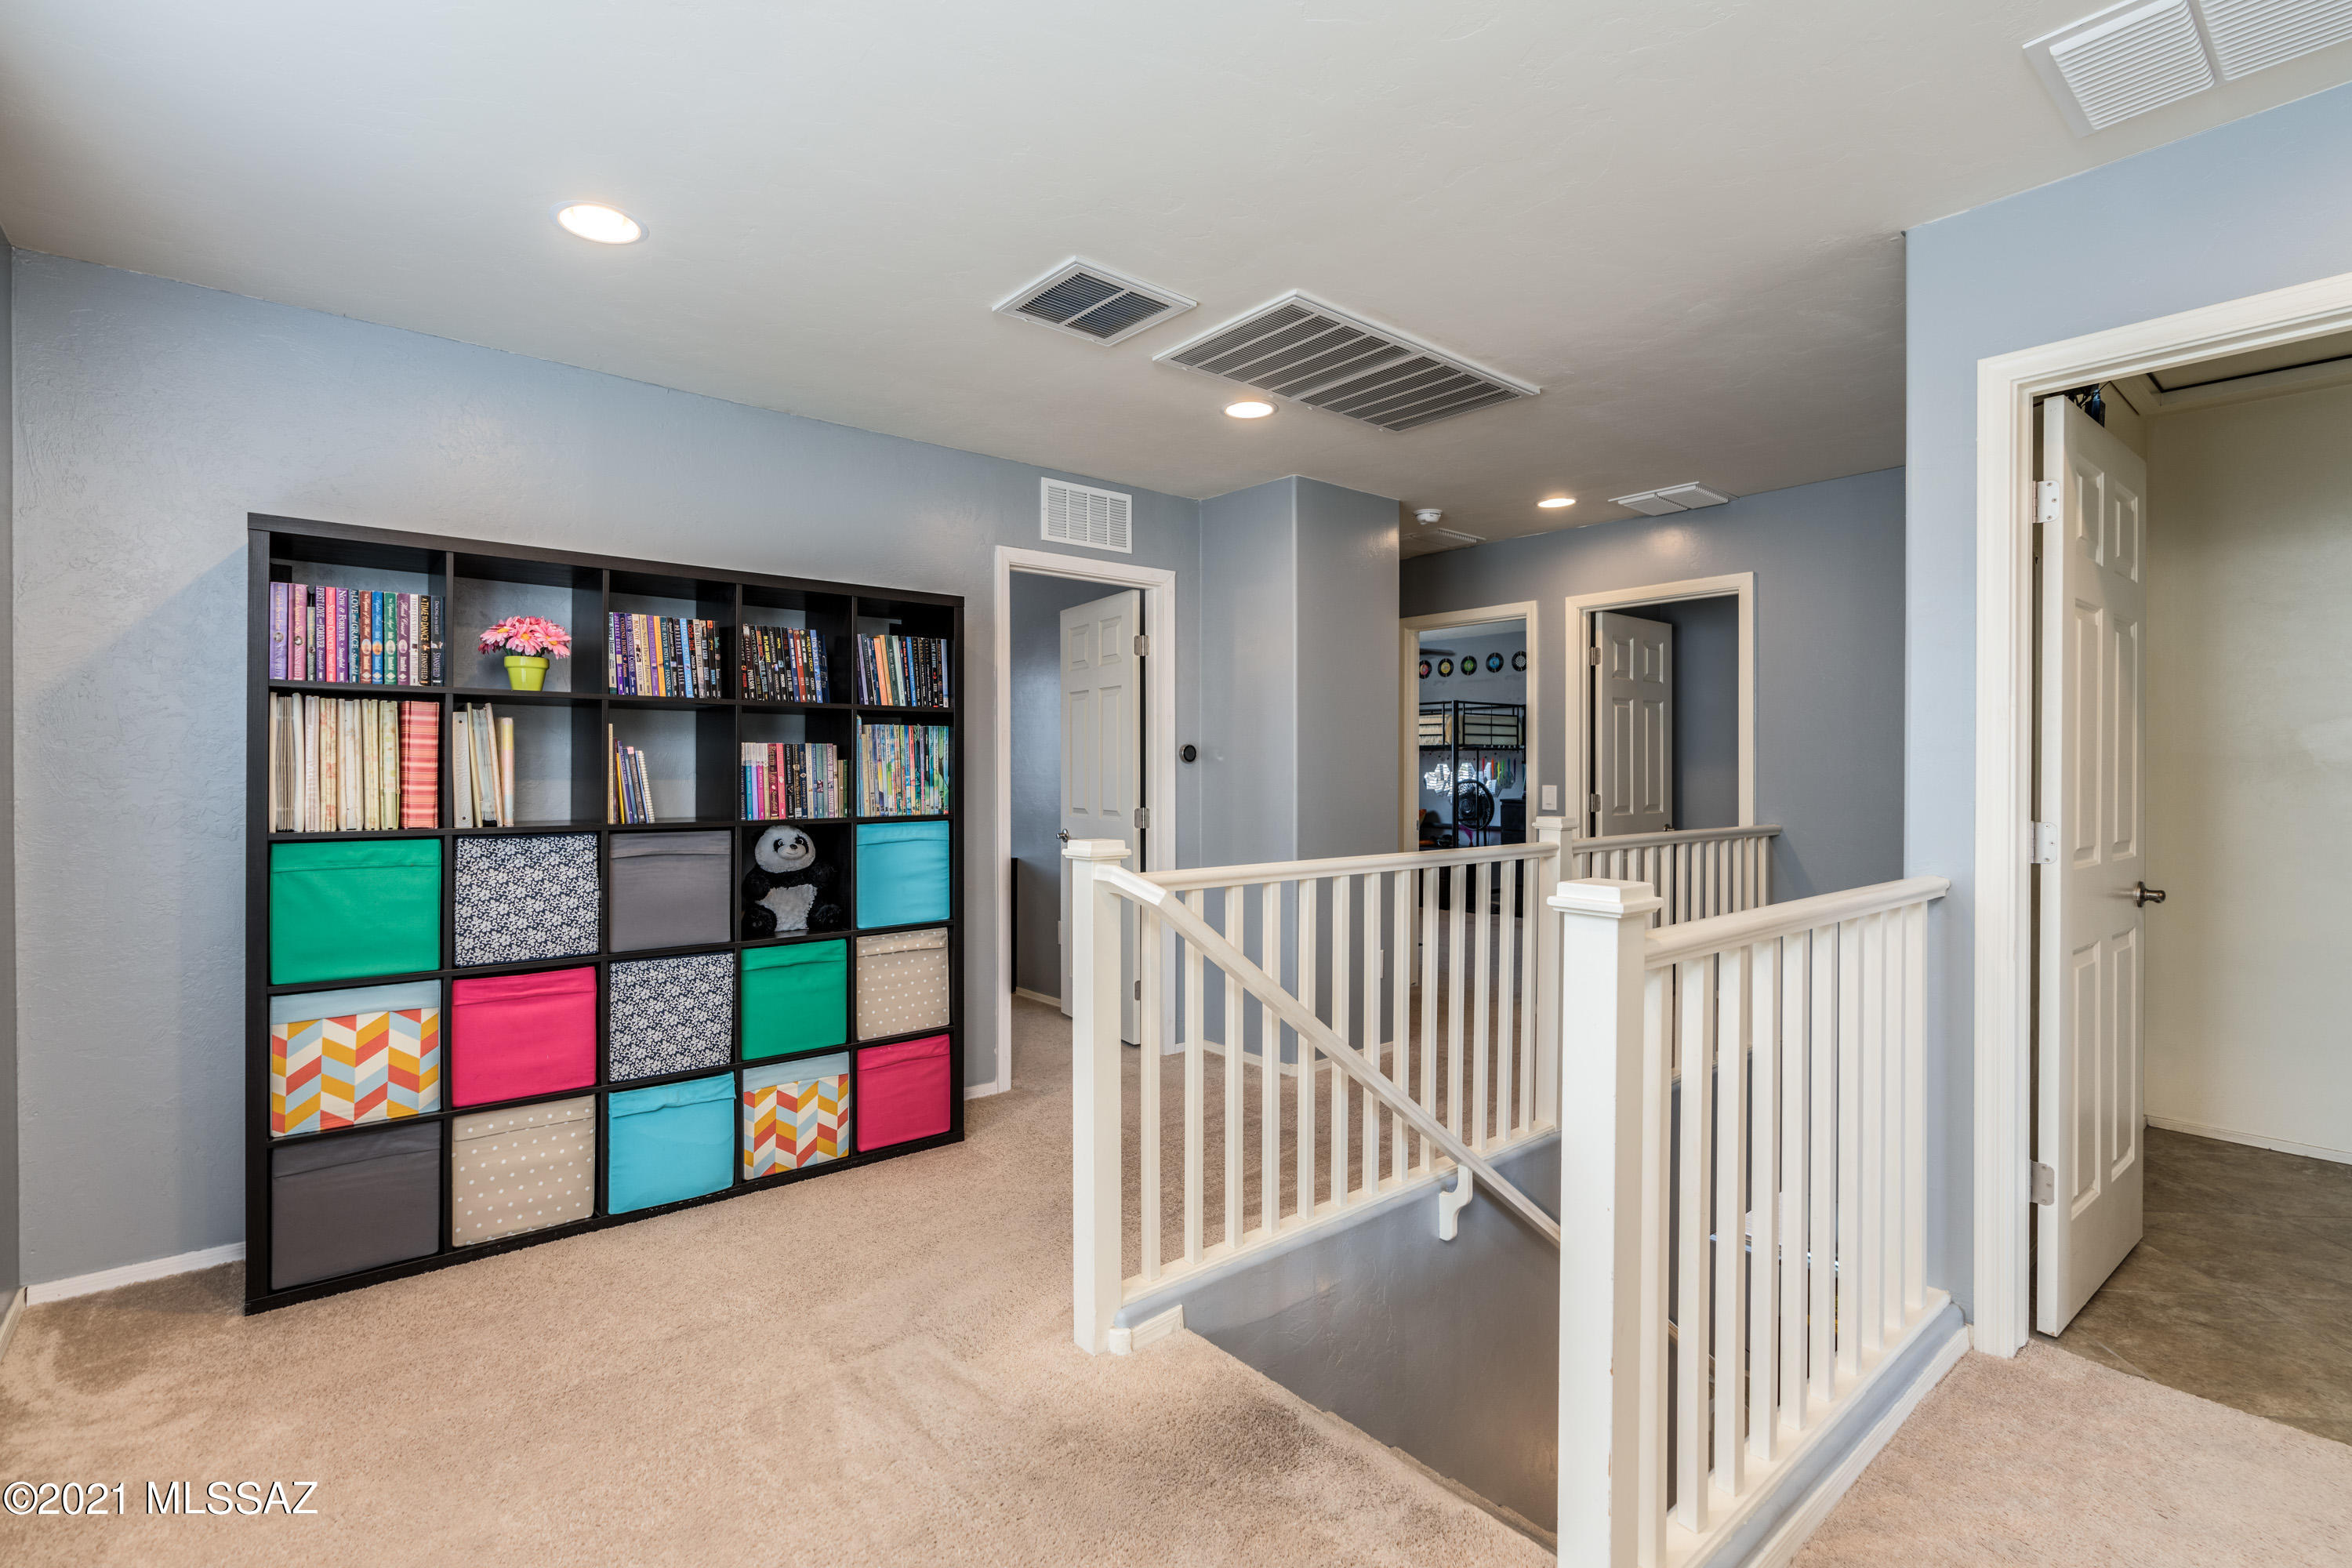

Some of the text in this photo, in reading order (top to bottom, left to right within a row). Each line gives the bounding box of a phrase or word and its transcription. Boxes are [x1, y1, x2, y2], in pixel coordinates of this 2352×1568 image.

[316, 587, 325, 601] FIRST
[317, 603, 325, 618] LOVE
[317, 625, 325, 648] FOREVER
[337, 648, 346, 668] Stansfield
[433, 652, 441, 677] STANSFIELD
